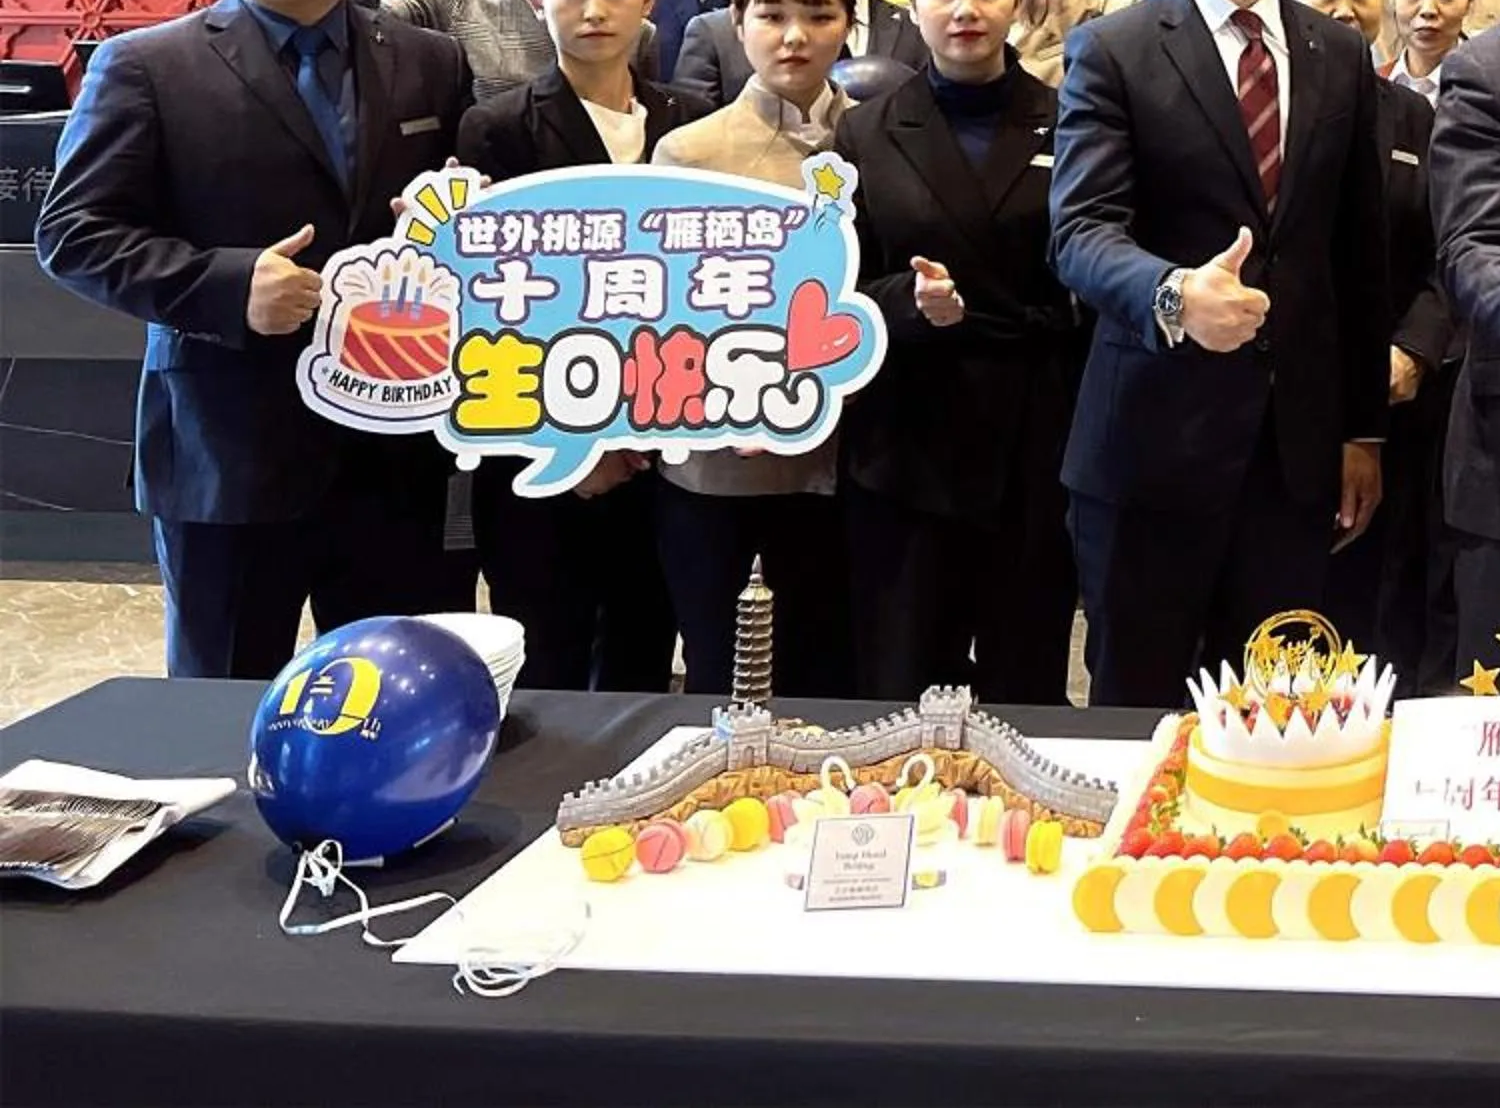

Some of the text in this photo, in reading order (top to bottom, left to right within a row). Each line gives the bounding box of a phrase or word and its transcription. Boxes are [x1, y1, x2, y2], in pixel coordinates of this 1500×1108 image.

[457, 212, 624, 254] 世外桃源
[329, 369, 452, 403] HAPPY BIRTHDAY
[454, 325, 824, 433] 生日快乐
